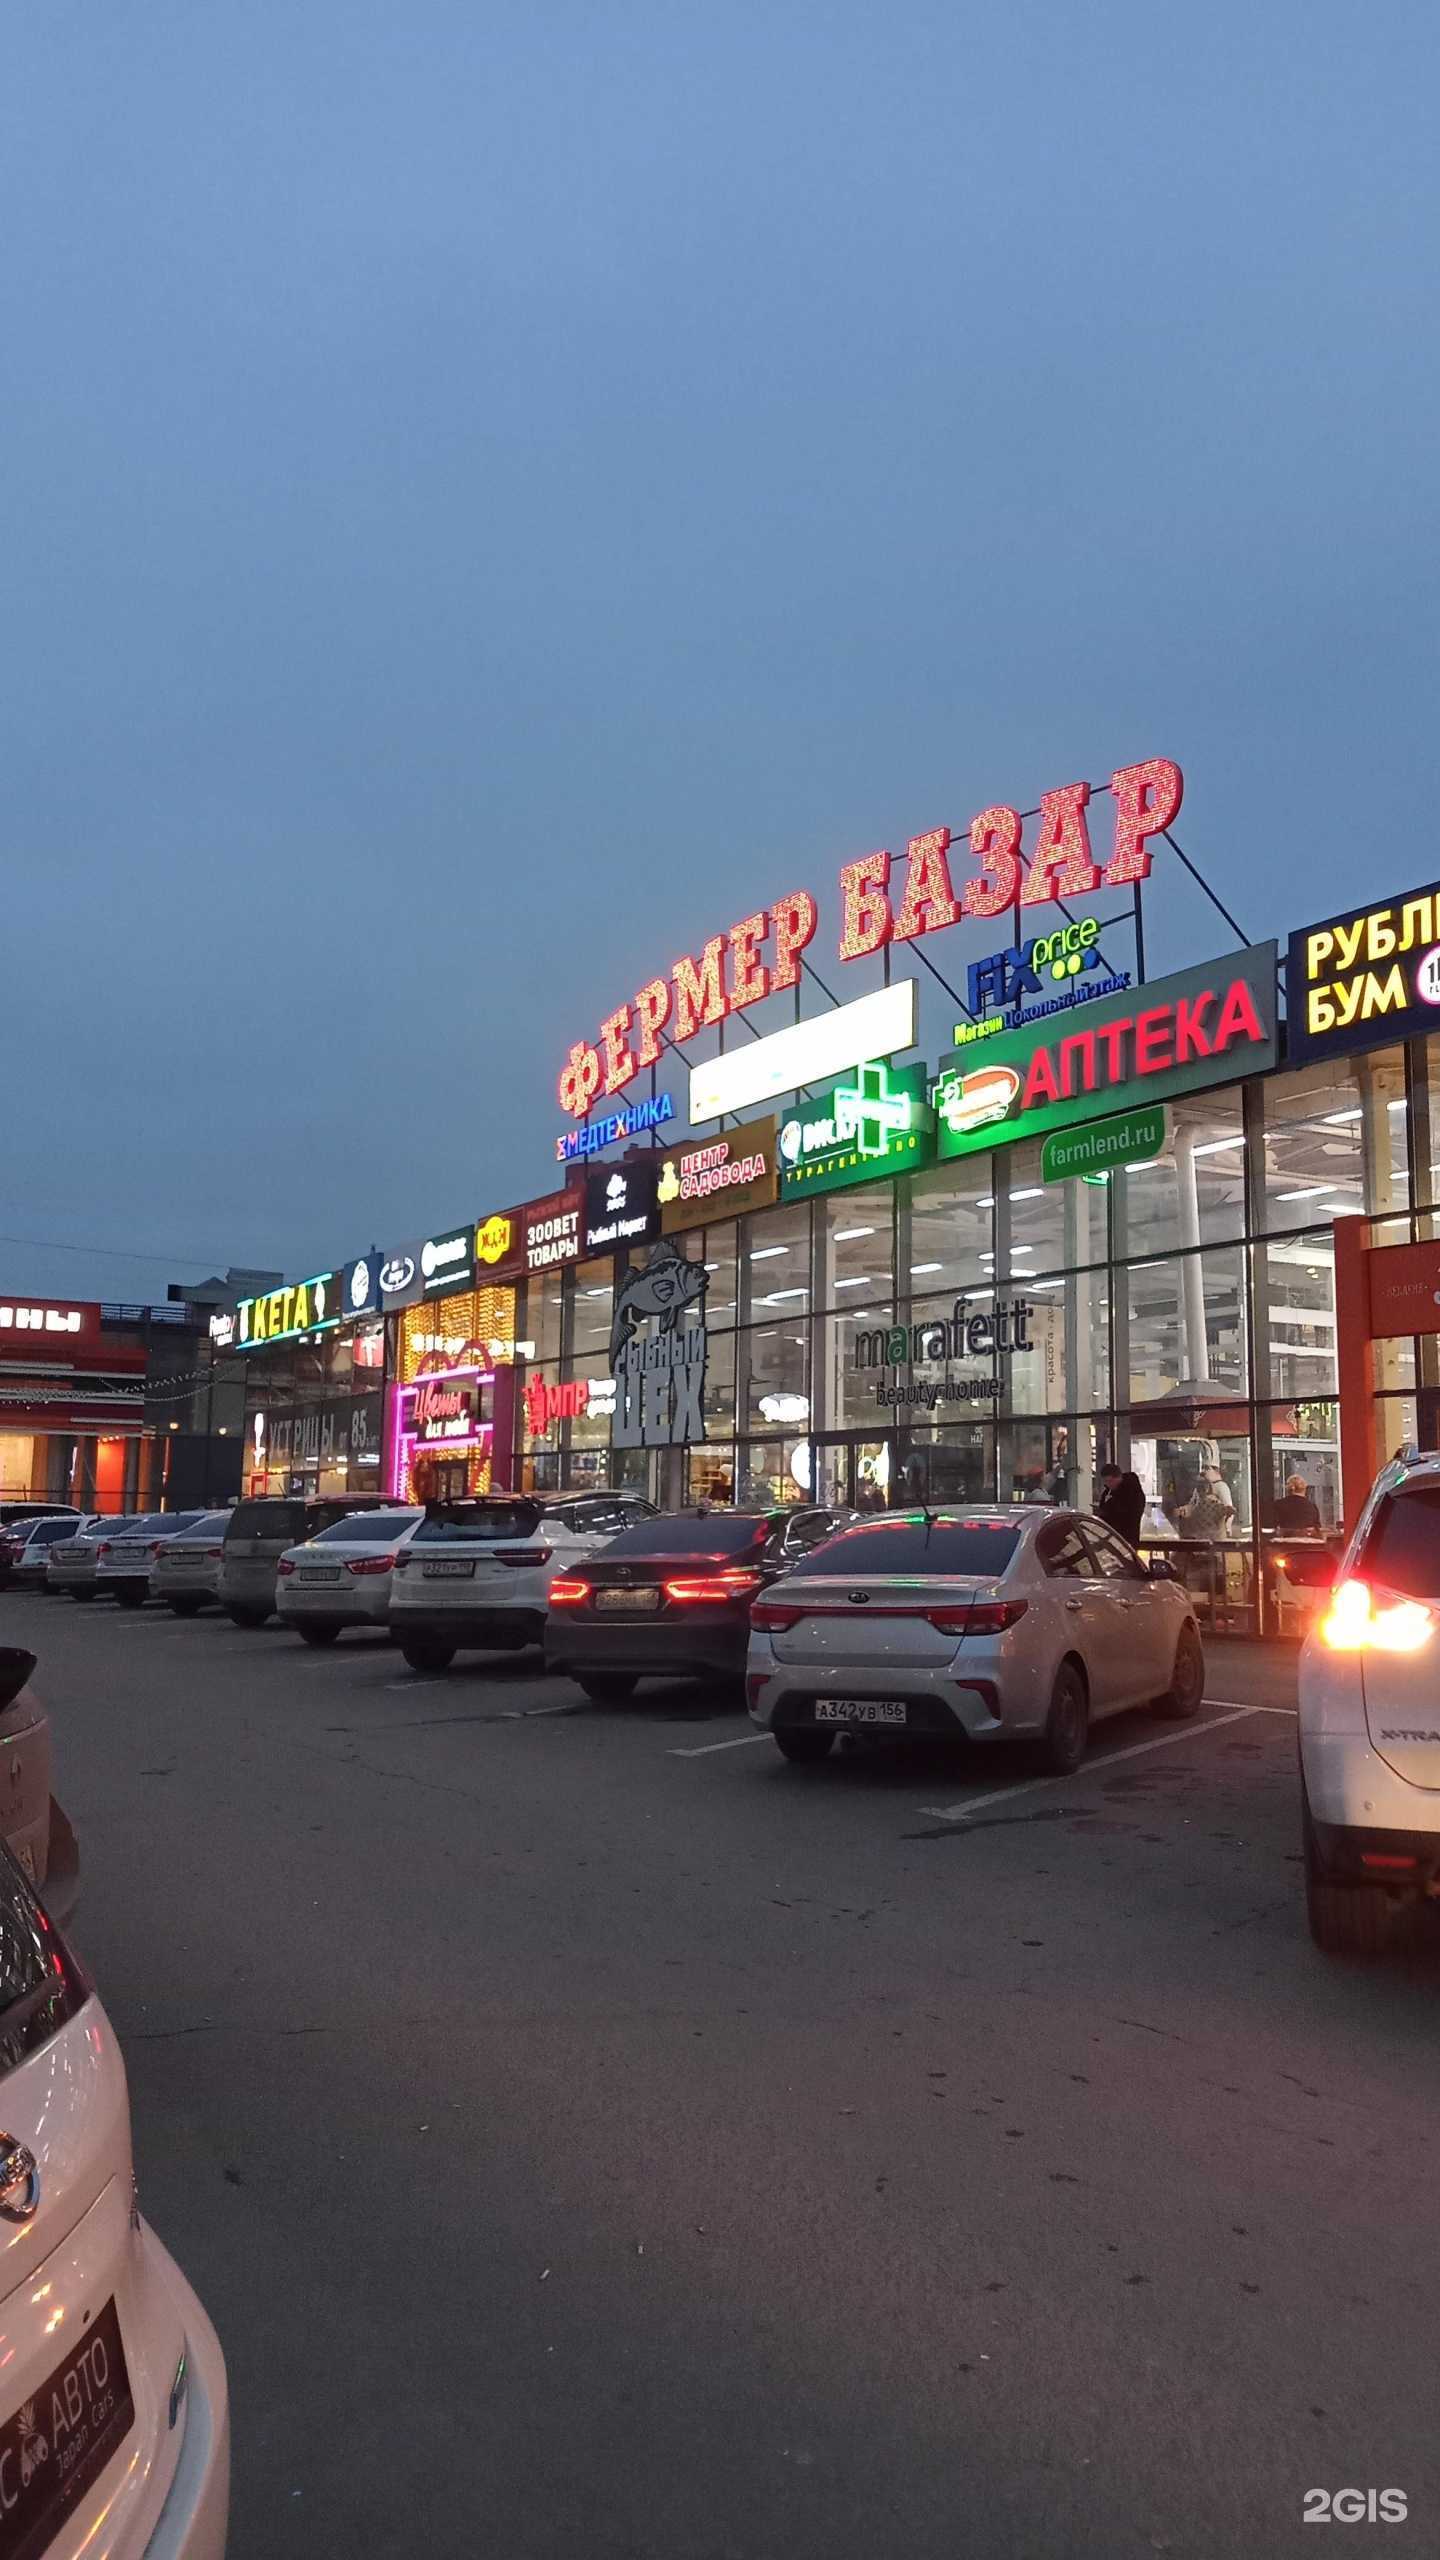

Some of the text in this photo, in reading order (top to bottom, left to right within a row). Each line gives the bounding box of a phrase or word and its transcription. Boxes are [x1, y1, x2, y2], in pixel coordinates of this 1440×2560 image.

[558, 757, 1184, 1119] ФЕРМЕР БАЗАР
[1033, 917, 1099, 974] price
[953, 1015, 1003, 1046] Магазин
[1005, 983, 1089, 1030] Цокольный
[1308, 963, 1407, 1035] БУМ
[1021, 979, 1266, 1110] АПТЕКА
[565, 1094, 674, 1157] МЕДТЕХНИКА
[1050, 1122, 1156, 1168] farmlend.ru
[680, 1153, 766, 1199] САДОВОДА
[681, 1143, 728, 1177] ЦЕНТР
[526, 1235, 579, 1269] ТОВАРЫ
[527, 1211, 579, 1246] ЗООВЕТ
[855, 1298, 1035, 1369] marafett
[414, 1381, 464, 1423] Цветы
[611, 1361, 706, 1449] ЦЕХ
[876, 1381, 939, 1411] beauty
[351, 1408, 368, 1449] 85
[52, 2336, 109, 2449] АВТО
[56, 2388, 115, 2479] Japan Cars
